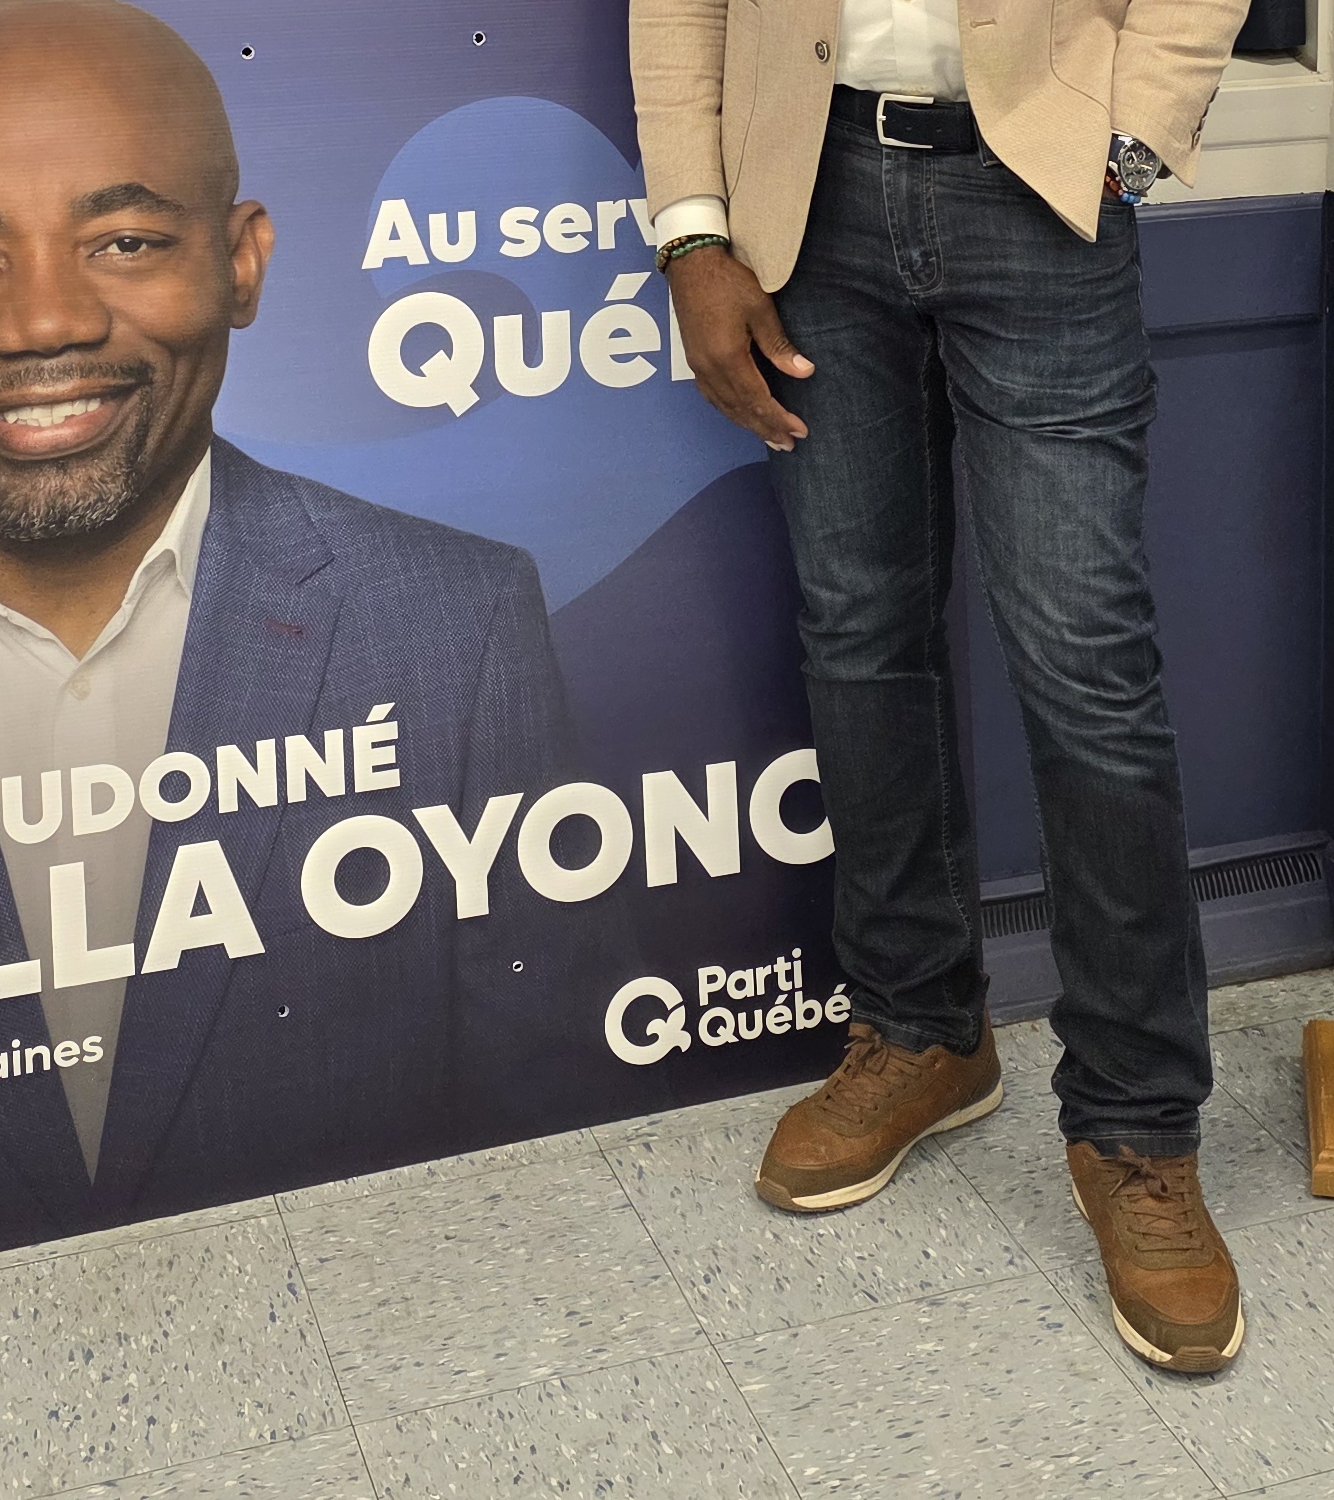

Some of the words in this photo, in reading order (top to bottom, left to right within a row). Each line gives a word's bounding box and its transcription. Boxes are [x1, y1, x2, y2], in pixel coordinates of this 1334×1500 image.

[361, 198, 477, 270] Au
[498, 197, 658, 258] serv
[367, 271, 696, 418] Qué
[300, 748, 836, 939] OYONO
[698, 947, 803, 1007] Parti
[698, 983, 852, 1047] Québé
